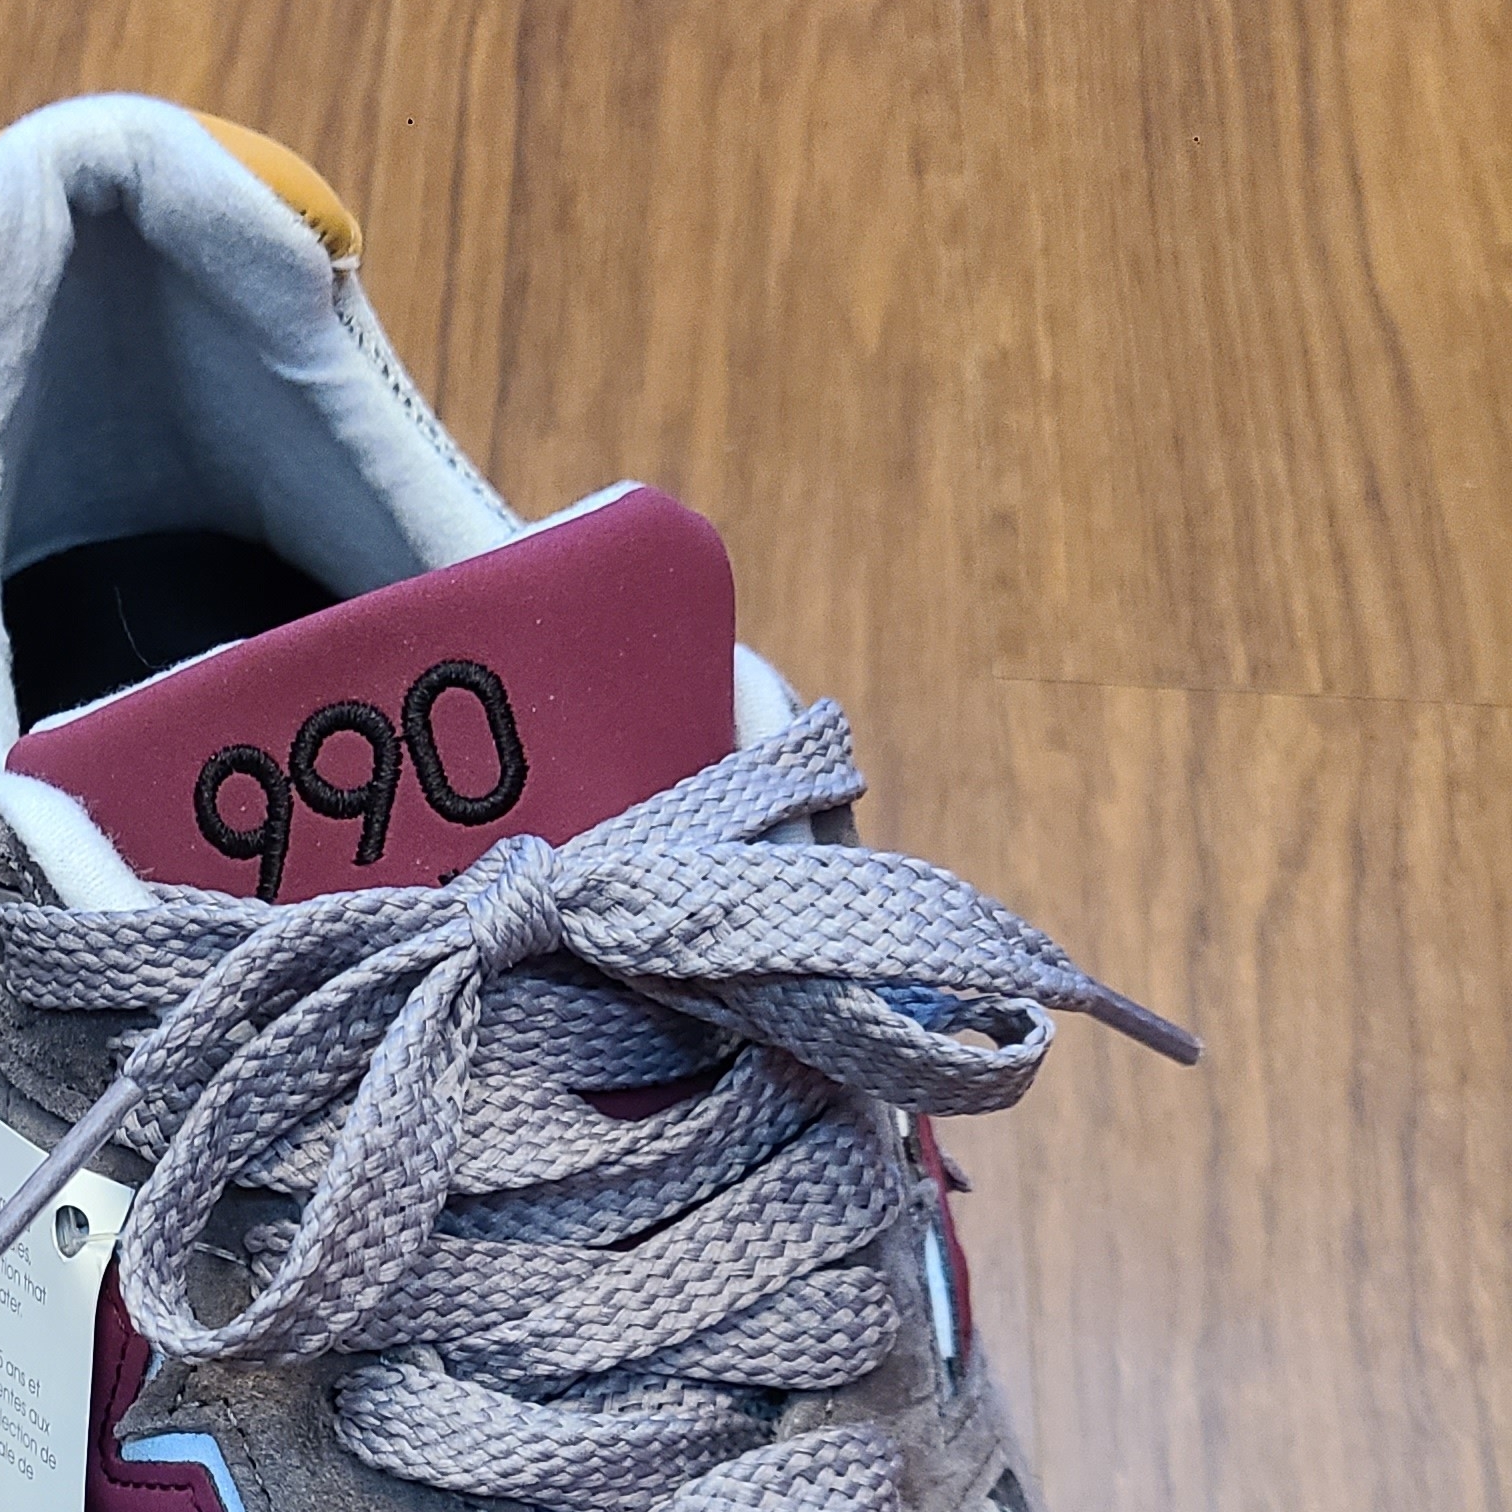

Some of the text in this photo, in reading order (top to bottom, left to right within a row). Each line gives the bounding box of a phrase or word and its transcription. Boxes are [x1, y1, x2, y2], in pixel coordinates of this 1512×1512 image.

[194, 659, 529, 900] 990
[24, 1271, 47, 1306] that
[5, 1360, 26, 1388] ans
[27, 1378, 41, 1397] et
[29, 1408, 51, 1437] aux
[17, 1456, 34, 1481] de
[39, 1446, 57, 1470] de
